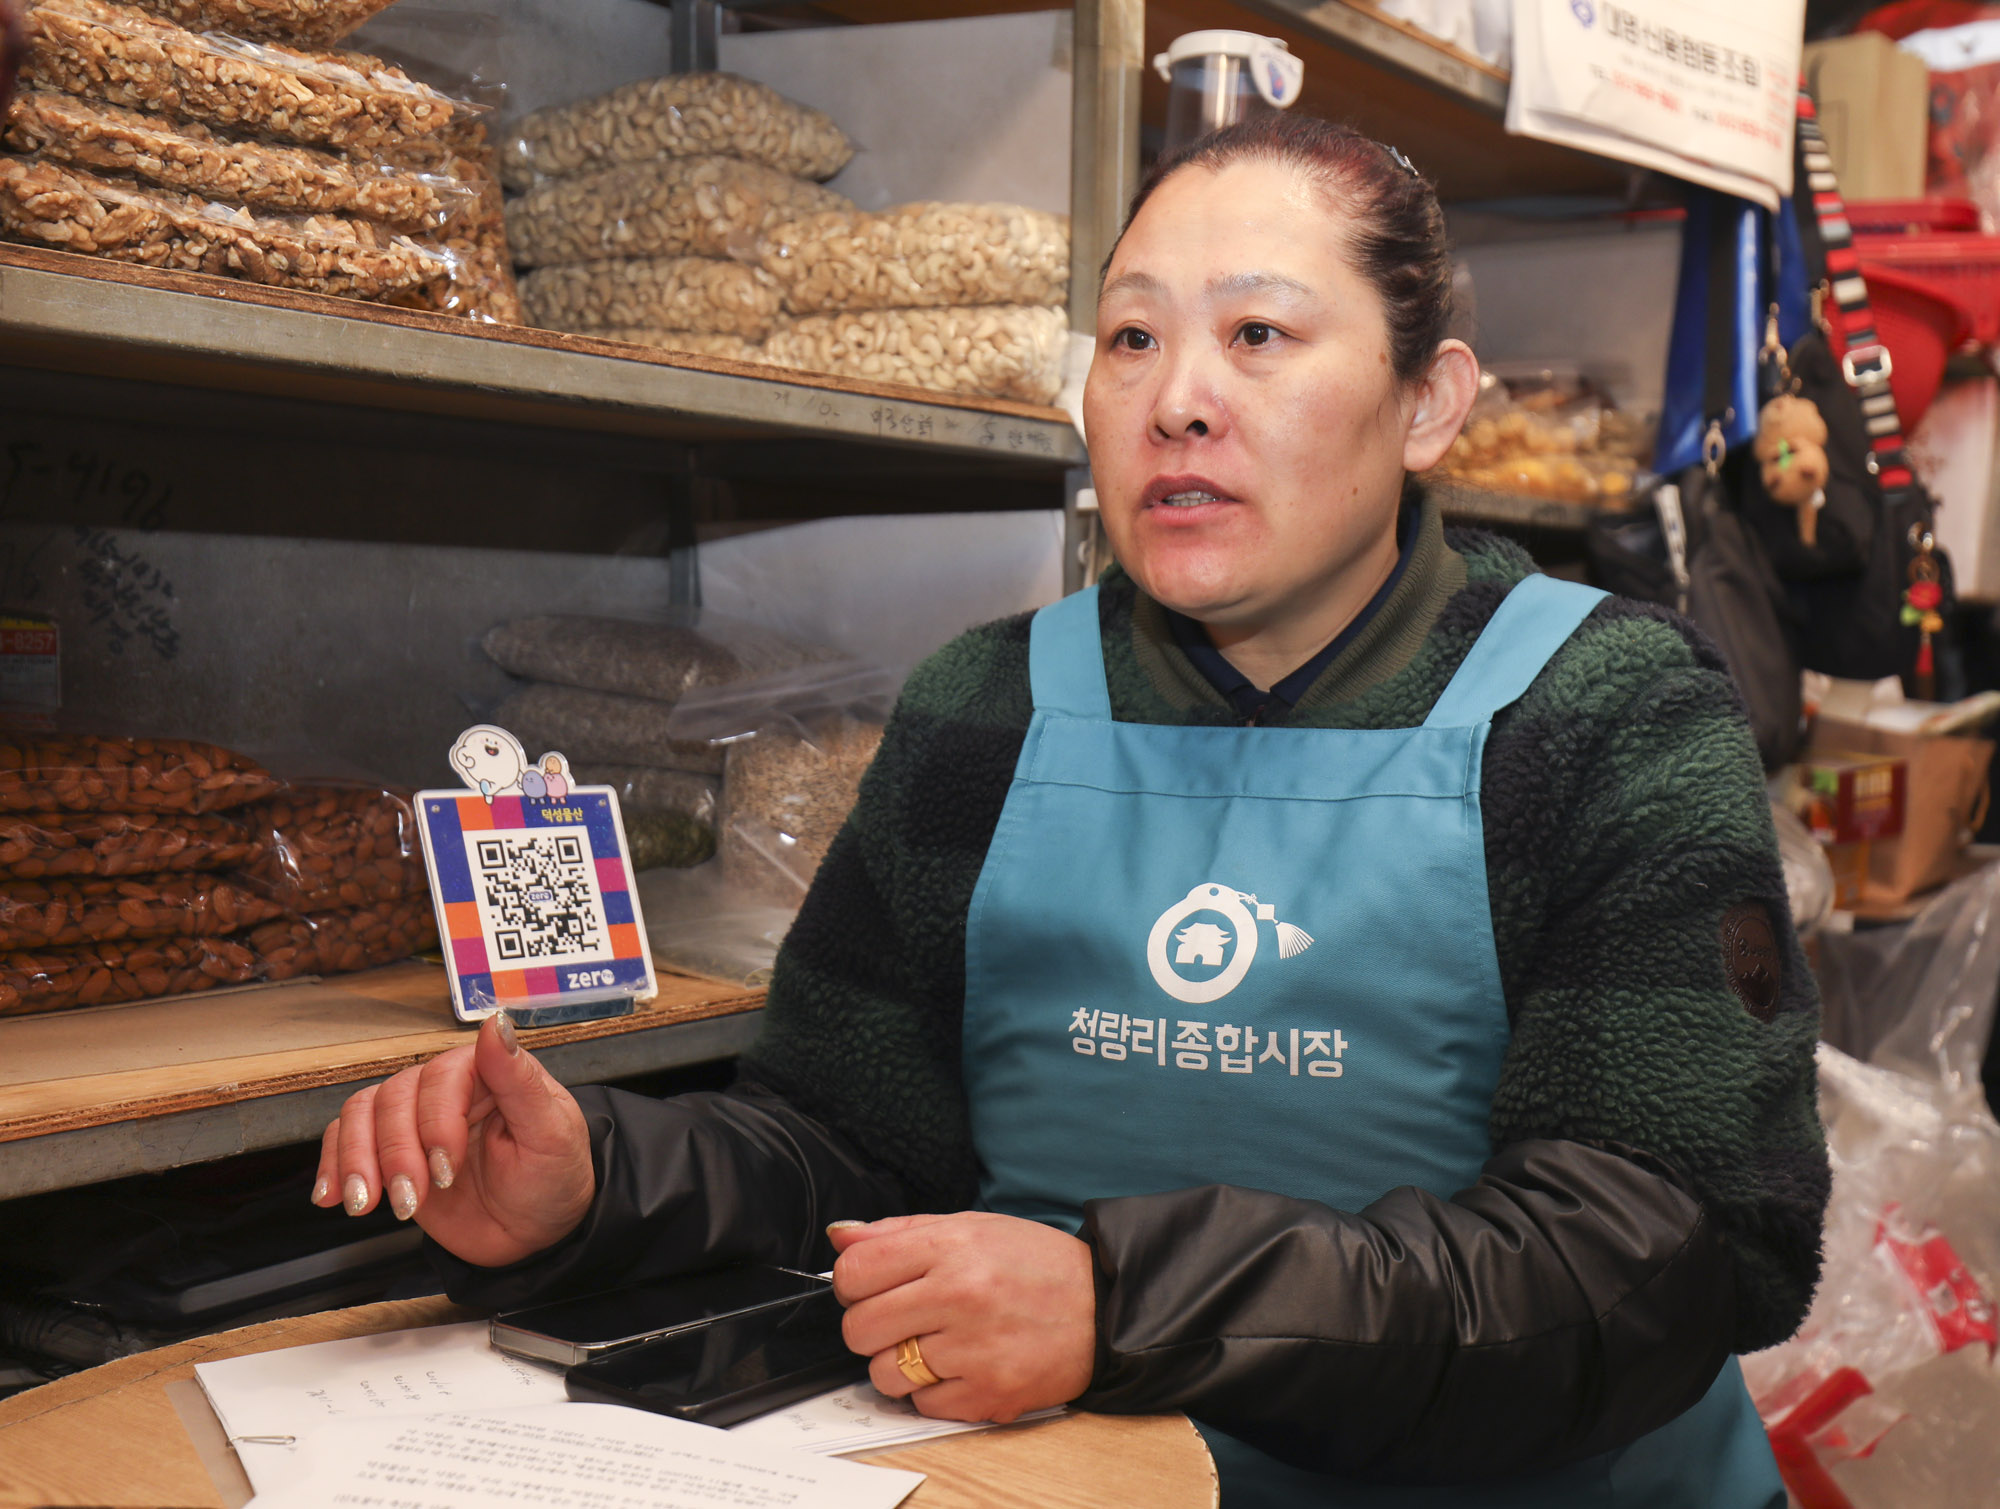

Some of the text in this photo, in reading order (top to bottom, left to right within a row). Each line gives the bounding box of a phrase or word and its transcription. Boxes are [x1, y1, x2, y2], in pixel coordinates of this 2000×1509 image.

[0, 631, 54, 651] -8257
[541, 807, 584, 823] 덕성물산
[567, 968, 615, 990] zero
[1068, 1006, 1349, 1078] 청량리종합시장
